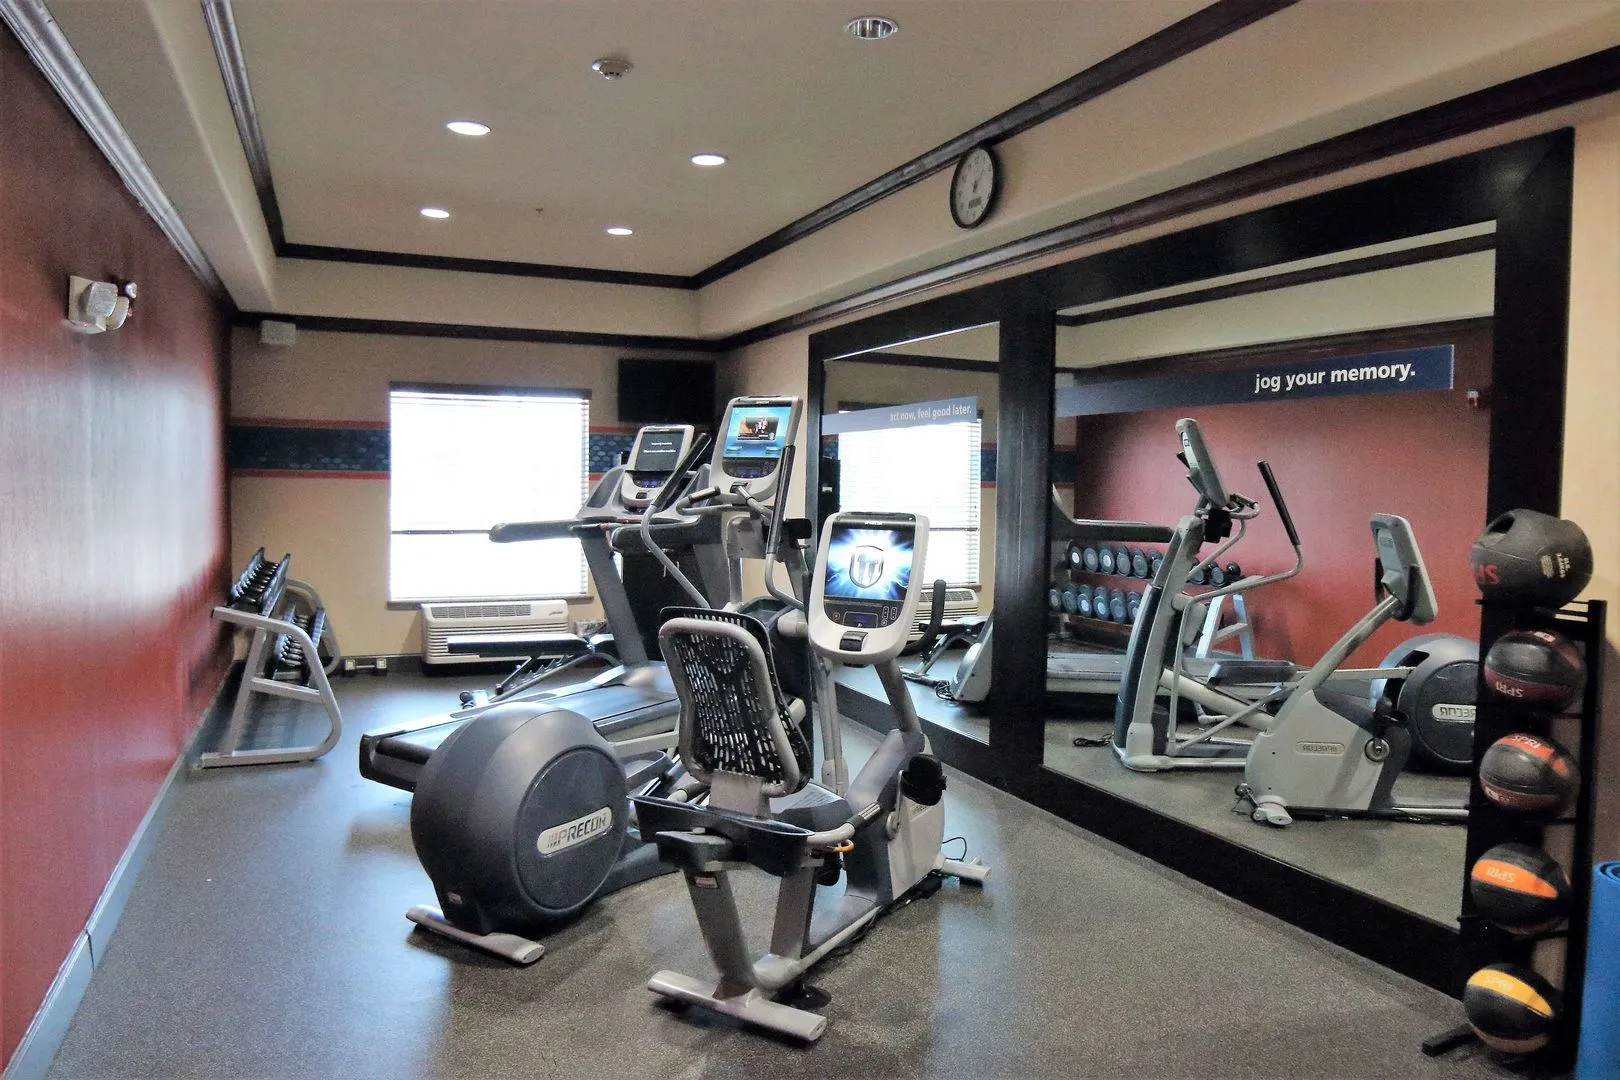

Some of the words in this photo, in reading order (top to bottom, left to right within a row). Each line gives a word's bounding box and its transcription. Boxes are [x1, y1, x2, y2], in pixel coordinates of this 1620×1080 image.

[1254, 373, 1281, 393] jog
[1286, 369, 1326, 391] your
[1330, 362, 1416, 382] memory.
[900, 412, 916, 421] now,
[918, 407, 931, 418] feel
[932, 405, 951, 420] good
[952, 404, 972, 415] later.
[1495, 681, 1524, 698] SPRI
[1511, 735, 1541, 749] SPRI
[1486, 866, 1516, 883] SPRI
